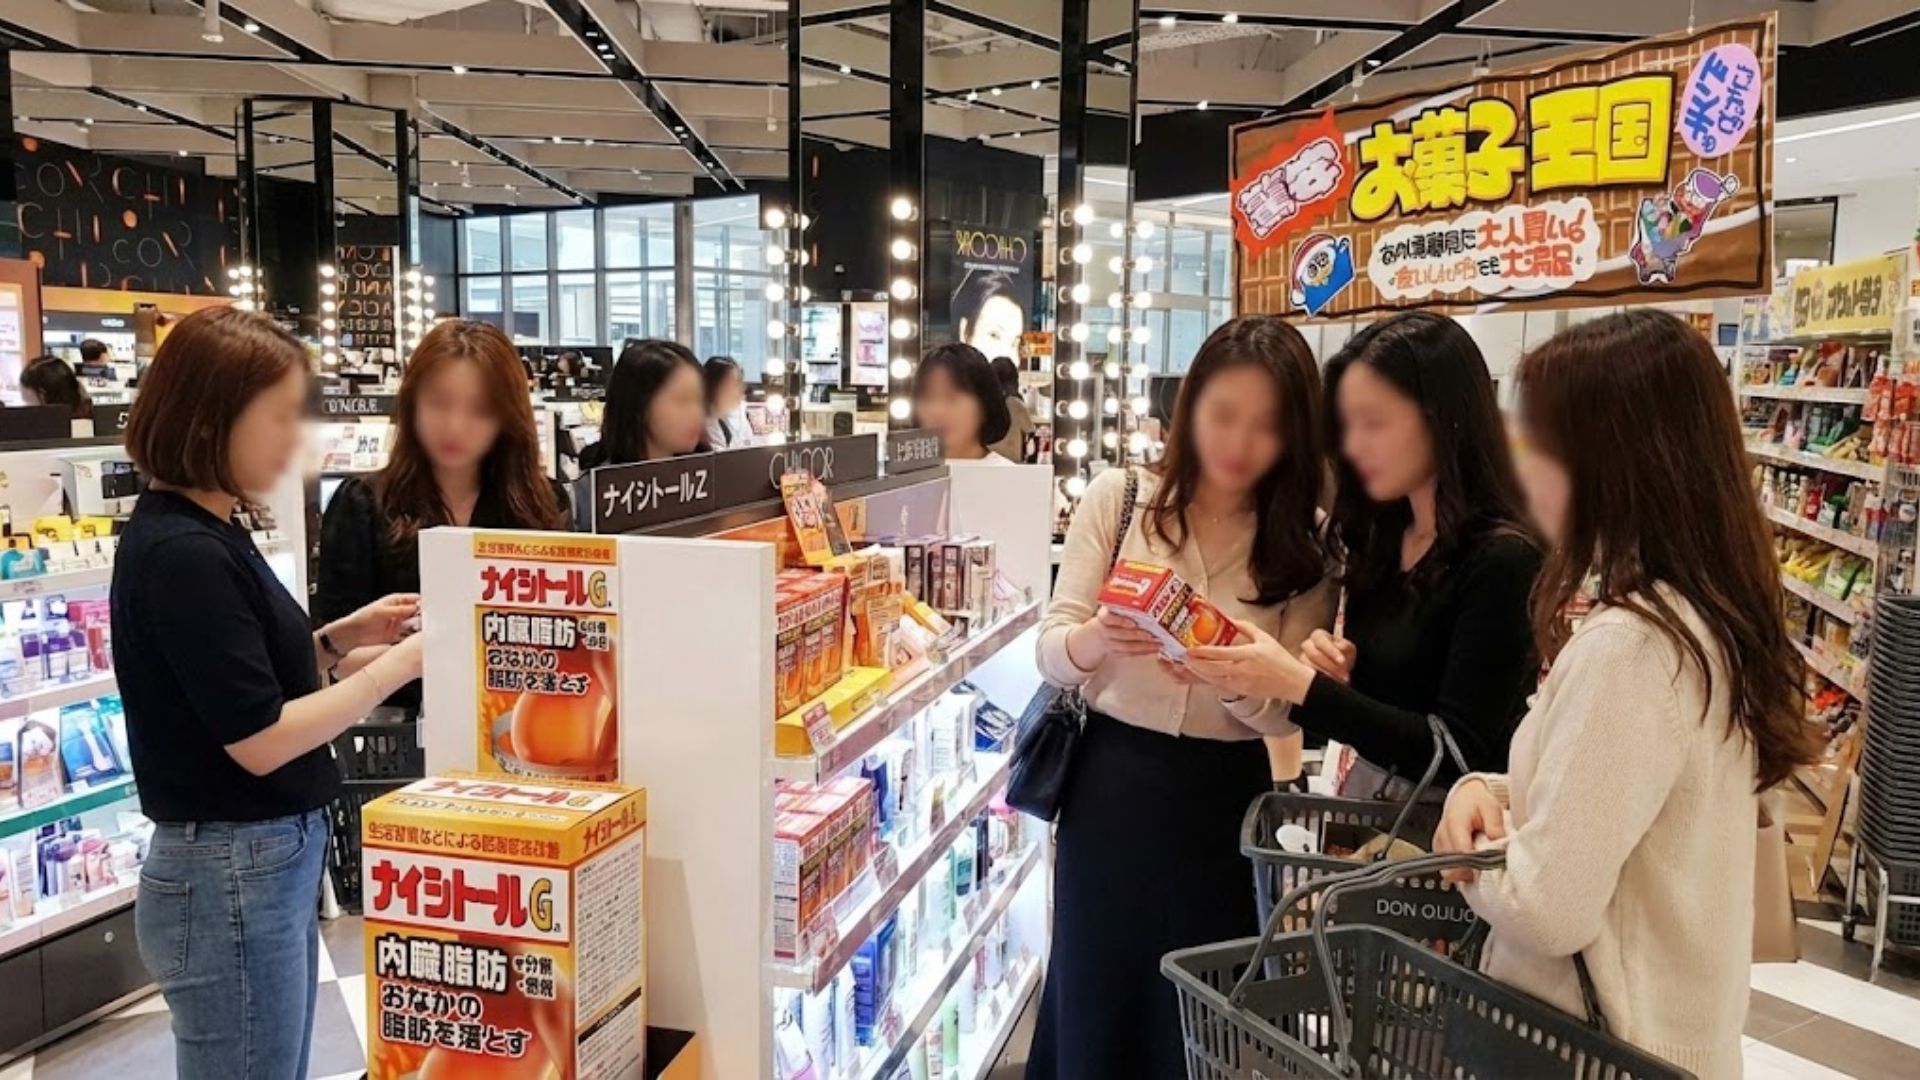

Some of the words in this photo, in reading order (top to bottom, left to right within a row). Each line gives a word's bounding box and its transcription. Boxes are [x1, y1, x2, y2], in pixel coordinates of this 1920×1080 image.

[603, 469, 709, 518] ナイシトールZ
[1376, 898, 1417, 917] DON
[377, 935, 508, 993] 内臓脂肪
[382, 983, 482, 1019] おなかの
[382, 1011, 531, 1056] 脂肪を落とす
